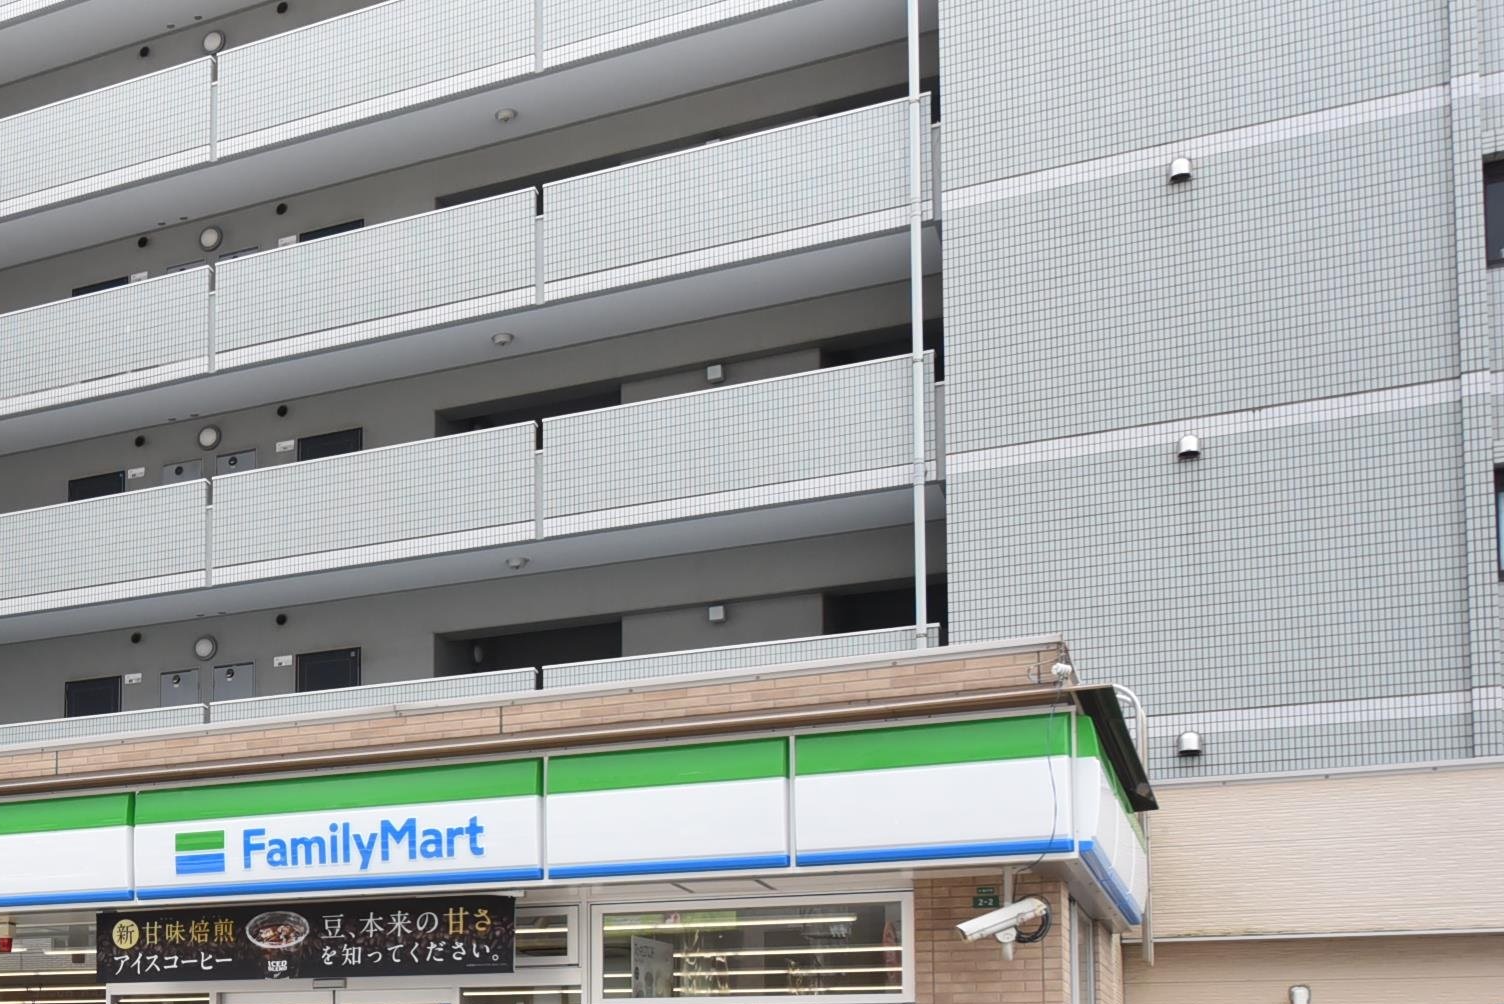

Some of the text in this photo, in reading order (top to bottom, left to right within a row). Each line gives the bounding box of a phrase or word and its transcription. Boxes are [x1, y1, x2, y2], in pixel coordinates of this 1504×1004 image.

[242, 815, 486, 871] FamilyMart
[978, 898, 994, 906] 2-2
[116, 918, 234, 945] 新 甘味焙煎
[320, 906, 492, 939] 豆、本来の甘さ
[113, 951, 233, 976] アイスコーヒー
[321, 940, 500, 967] を知ってください。
